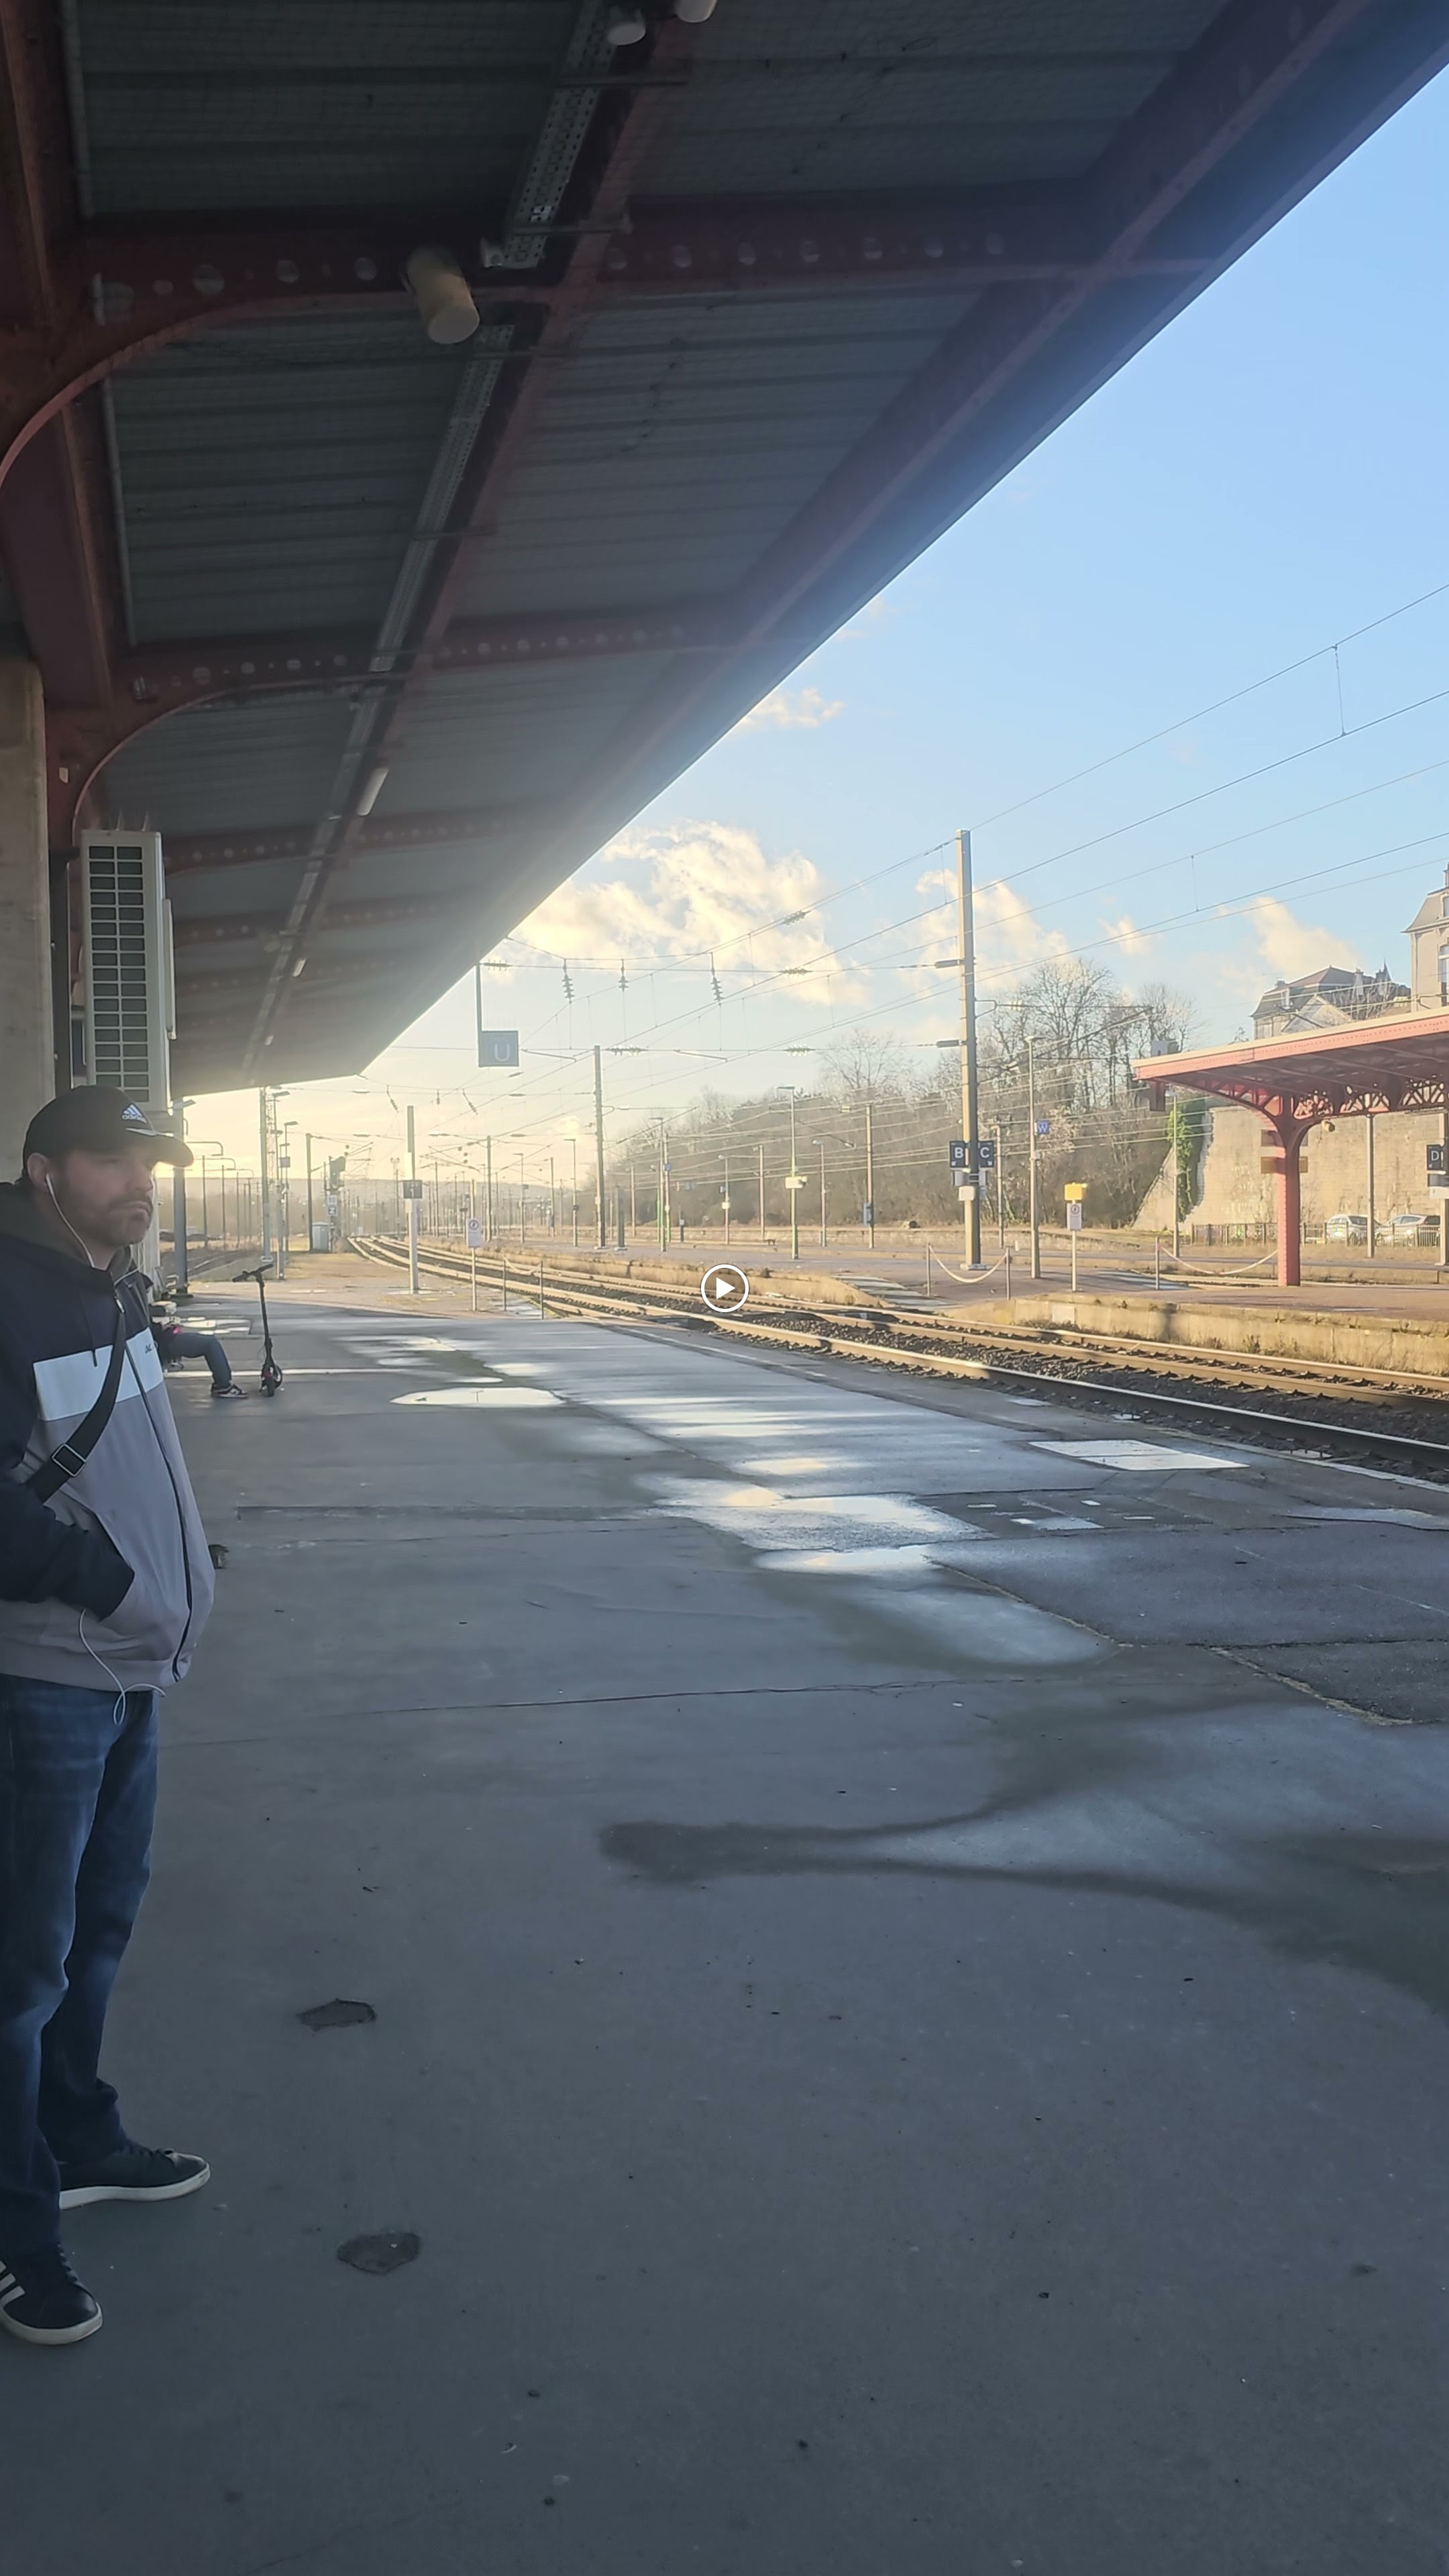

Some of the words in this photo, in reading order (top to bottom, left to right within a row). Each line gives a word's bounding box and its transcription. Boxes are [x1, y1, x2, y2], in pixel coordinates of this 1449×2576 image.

[494, 1043, 511, 1062] U
[1038, 1122, 1048, 1134] W
[955, 1146, 963, 1159] B
[980, 1146, 989, 1159] C
[1431, 1150, 1440, 1161] D
